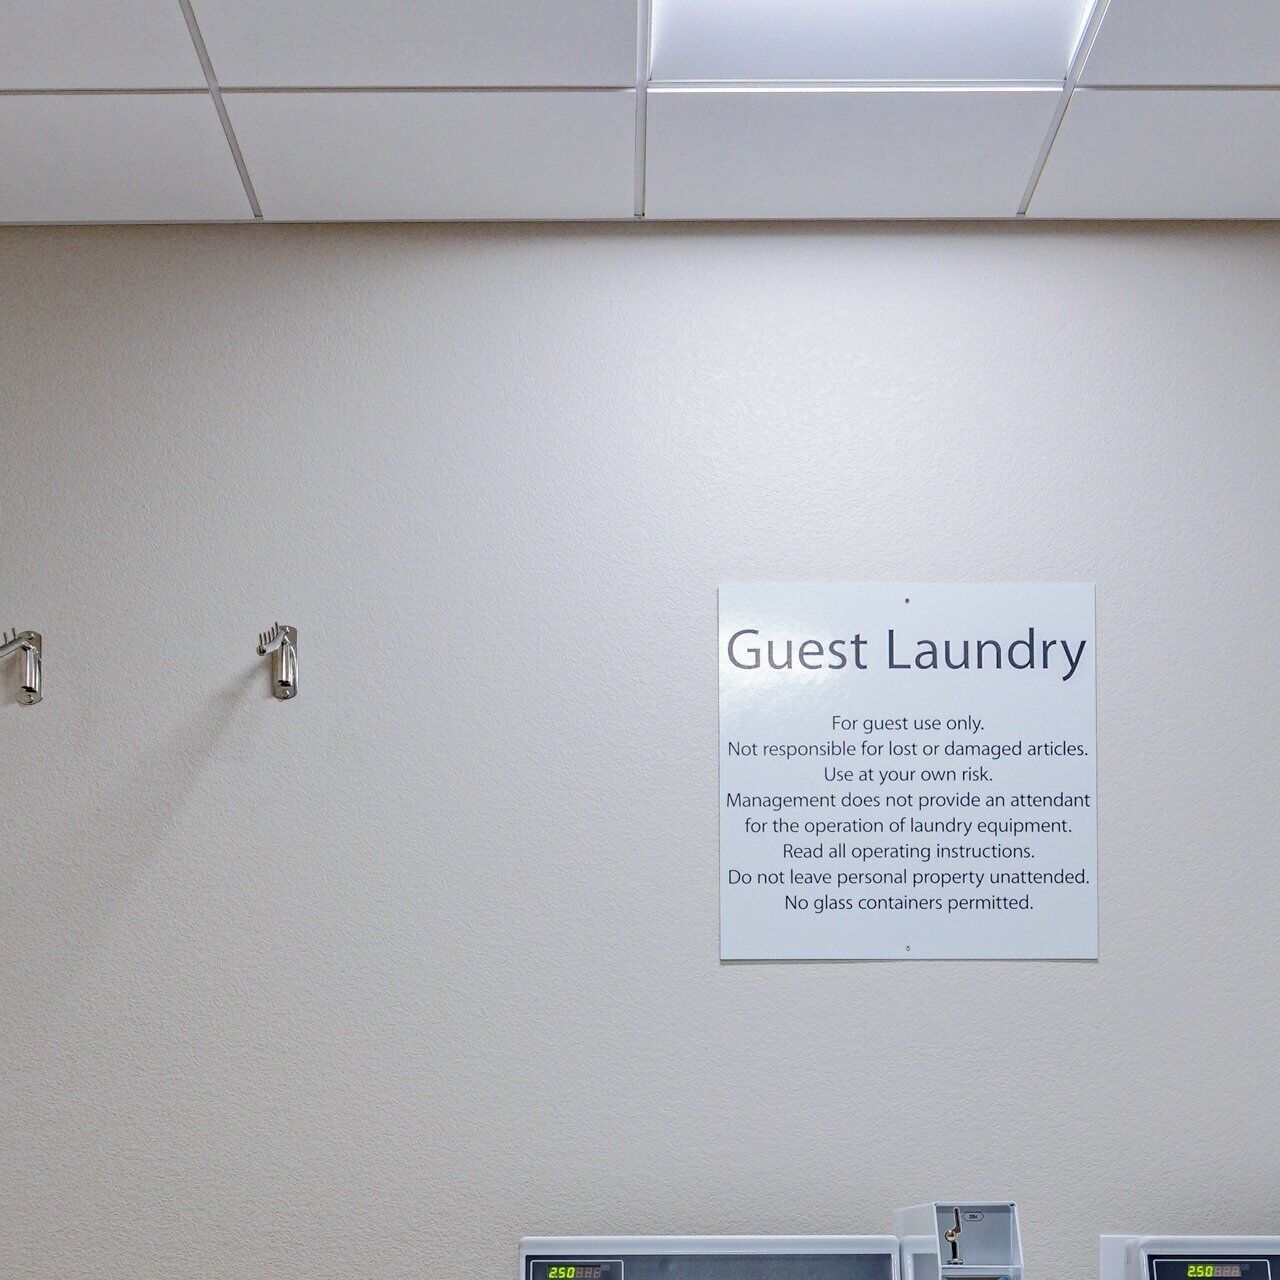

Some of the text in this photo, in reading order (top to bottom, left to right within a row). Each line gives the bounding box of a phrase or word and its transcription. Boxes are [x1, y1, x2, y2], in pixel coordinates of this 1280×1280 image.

[728, 627, 1087, 682] Guest Laundry
[832, 715, 984, 734] For guest use only.
[728, 740, 1088, 760] Not responsible for lost or damaged articles.
[825, 766, 993, 785] Use at your own risk.
[726, 791, 1091, 811] Management does not provide an attendant
[745, 817, 1072, 837] for the operation of laundry equipment.
[783, 843, 1034, 861] Read all operating instructions.
[729, 868, 1089, 888] Do not leave personal property unattended.
[785, 894, 1033, 914] No glass containers permitted.
[548, 1266, 575, 1279] 2.50
[1187, 1265, 1213, 1277] 2.50
